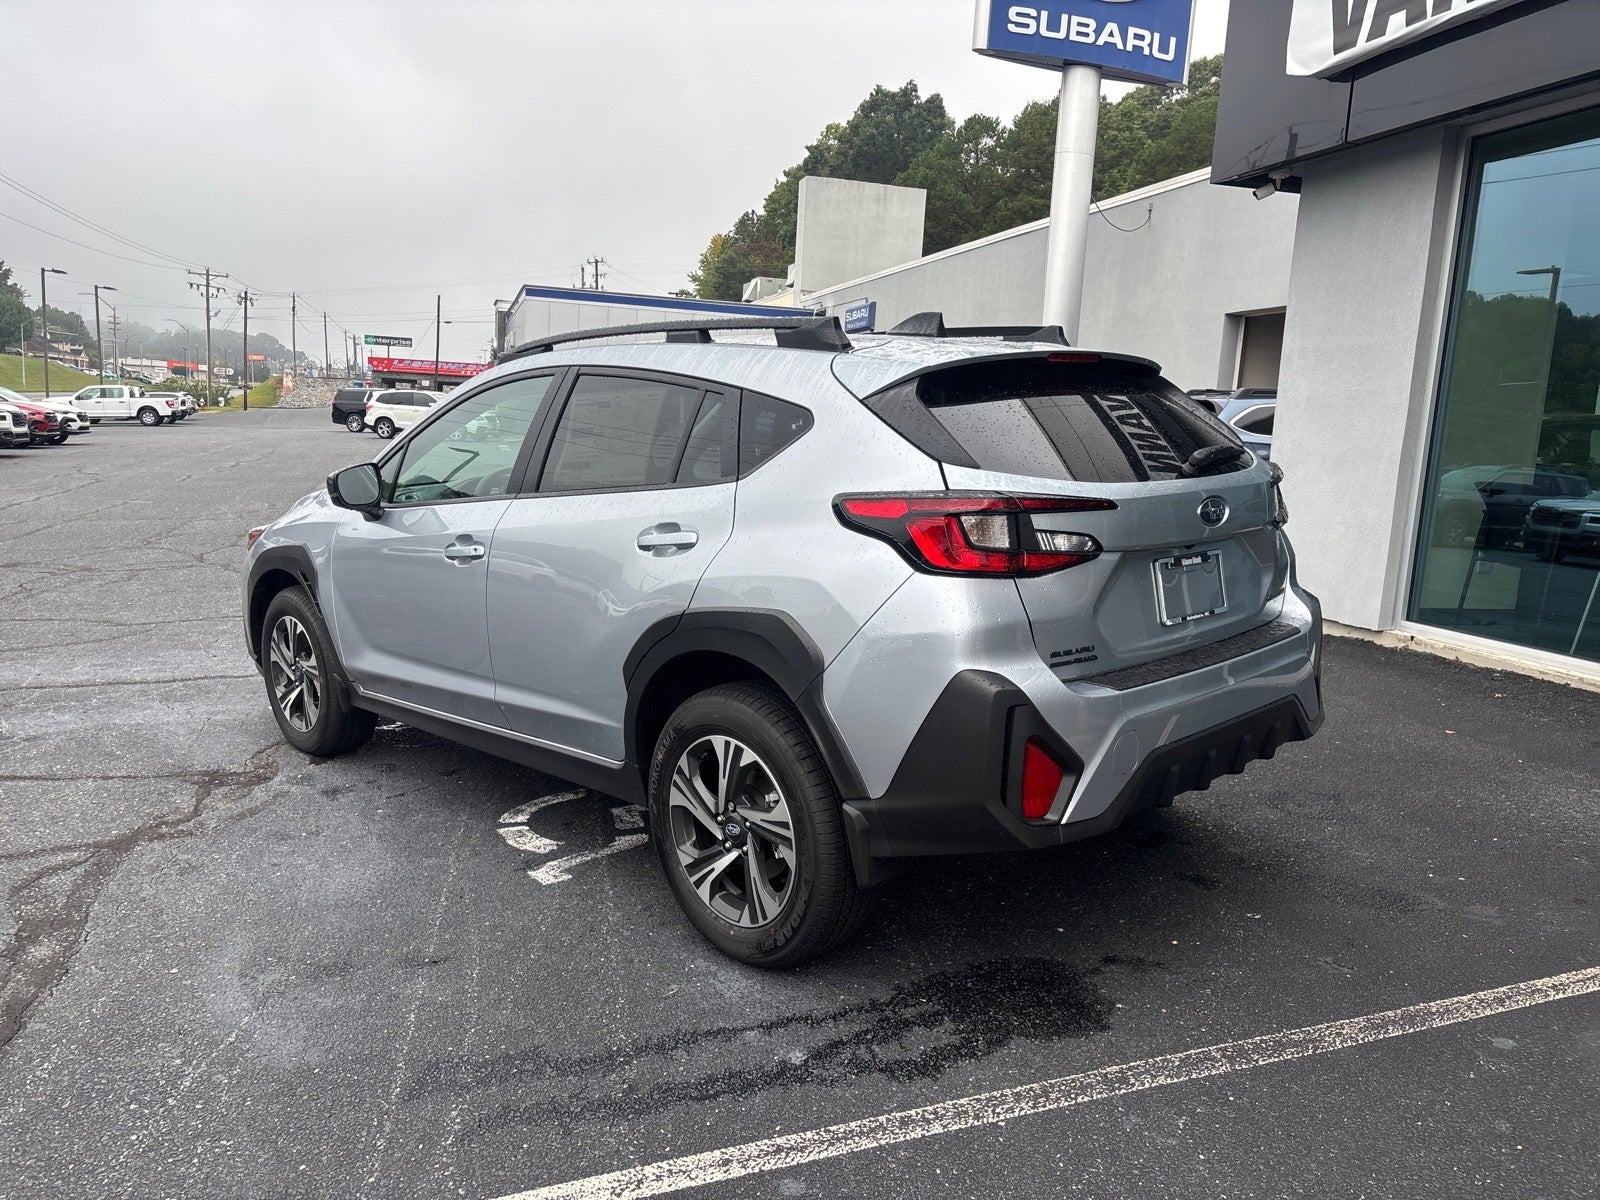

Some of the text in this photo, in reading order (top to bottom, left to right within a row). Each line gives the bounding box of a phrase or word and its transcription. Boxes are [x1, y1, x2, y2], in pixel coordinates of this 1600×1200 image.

[1007, 5, 1177, 62] SUBARU
[1332, 0, 1477, 56] VA
[365, 337, 412, 345] enterprise
[846, 308, 869, 321] SUBARU
[650, 729, 677, 794] YOKOHAMA
